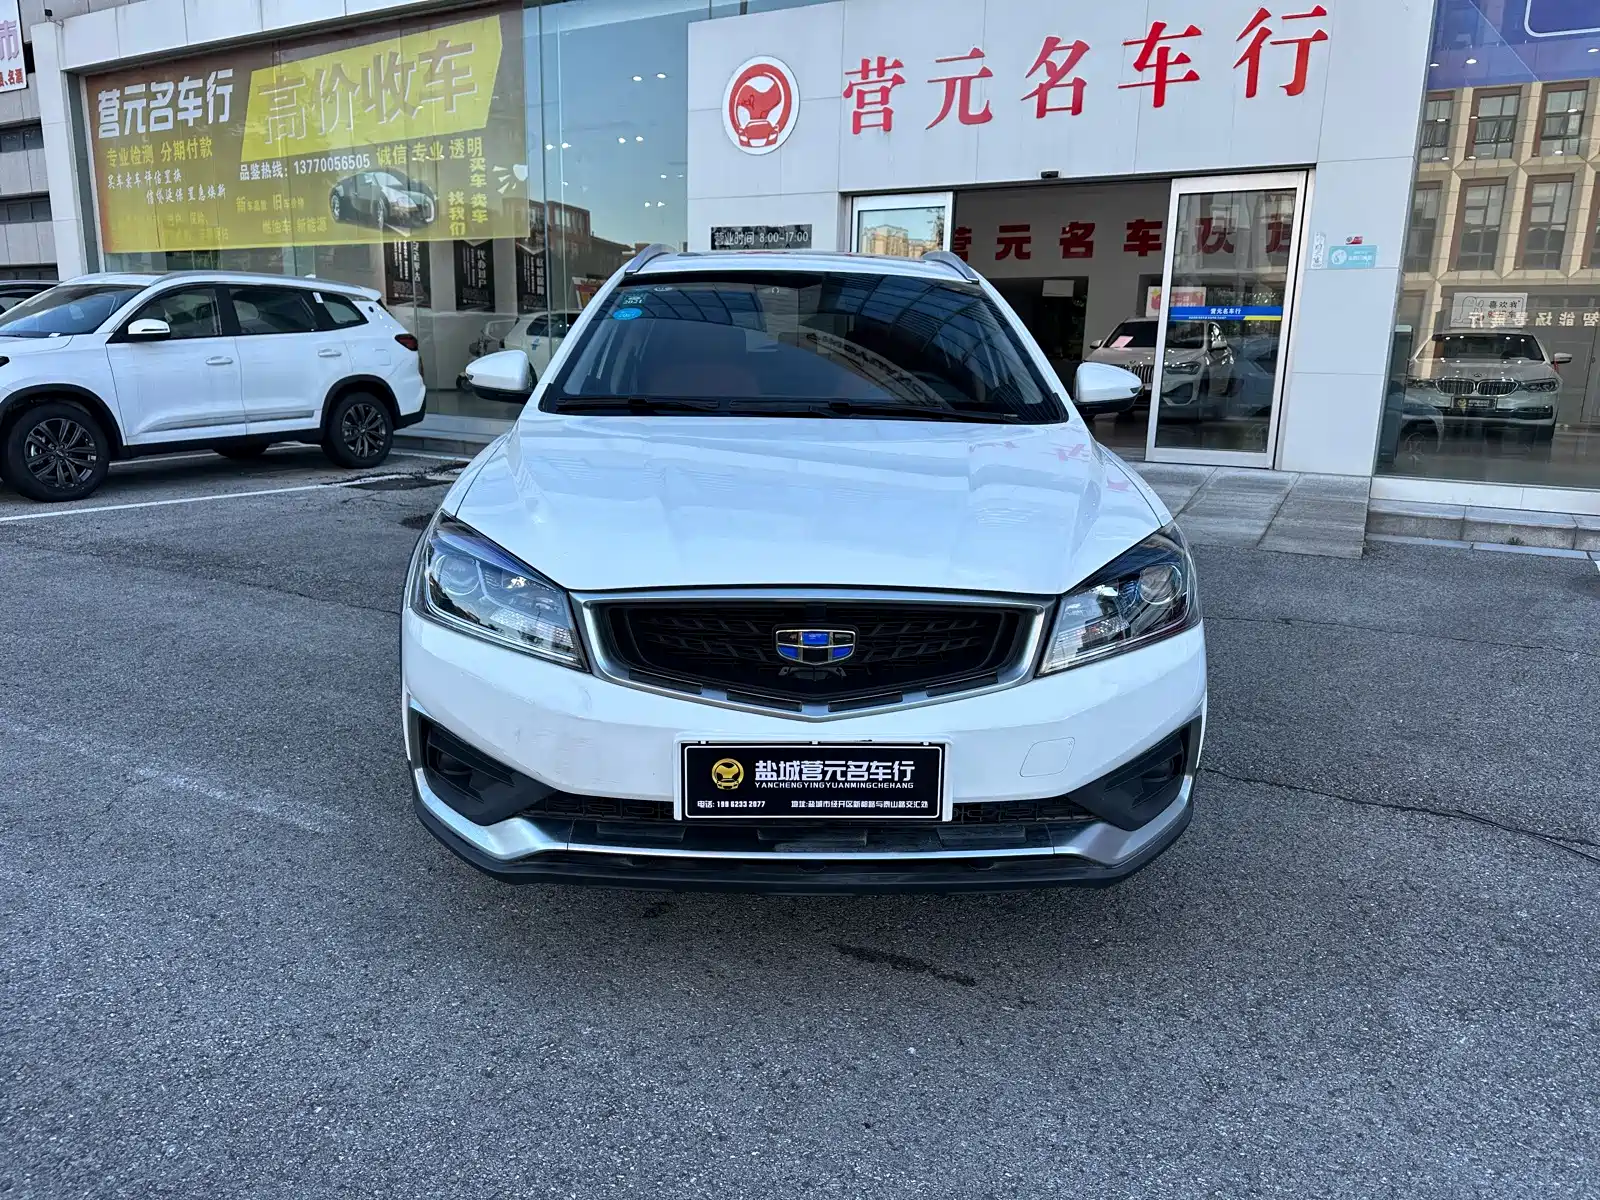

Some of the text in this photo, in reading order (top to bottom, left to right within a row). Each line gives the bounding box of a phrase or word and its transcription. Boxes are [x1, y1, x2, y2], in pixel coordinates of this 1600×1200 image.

[842, 6, 1329, 136] 营元名车行
[97, 68, 234, 139] 营元名车行
[257, 40, 478, 144] 高价收车
[106, 136, 213, 168] 专业检测 分期付款
[293, 153, 371, 175] 13770056505
[376, 136, 483, 167] 诚信 专业 透明
[469, 158, 487, 188] 买车
[448, 191, 466, 236] 找我们
[470, 193, 489, 224] 卖车
[714, 231, 809, 246] 营业时间 8:00-17:00
[1209, 307, 1242, 315] 营元名车行
[754, 760, 916, 782] 盐城营元名车行
